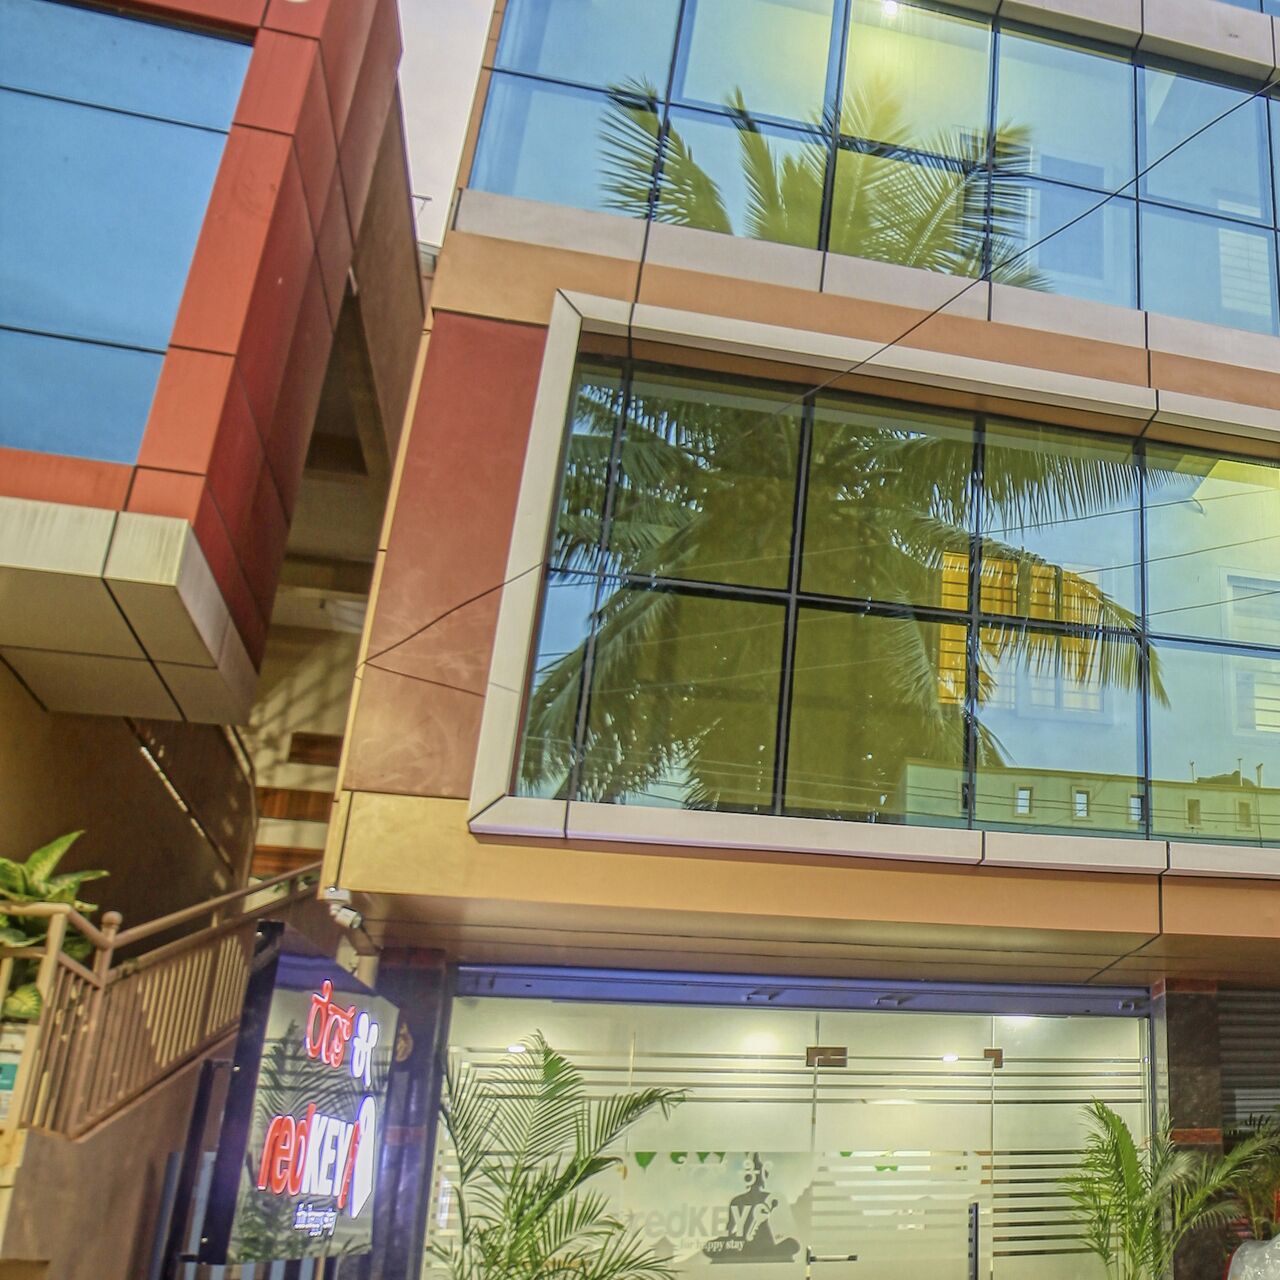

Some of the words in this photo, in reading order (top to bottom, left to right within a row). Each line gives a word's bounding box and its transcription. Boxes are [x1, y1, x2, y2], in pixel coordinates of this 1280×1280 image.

[257, 1103, 354, 1196] redKEY
[633, 1203, 752, 1238] redKEY
[680, 1240, 697, 1250] for
[697, 1241, 725, 1252] happy
[725, 1240, 744, 1251] stay
